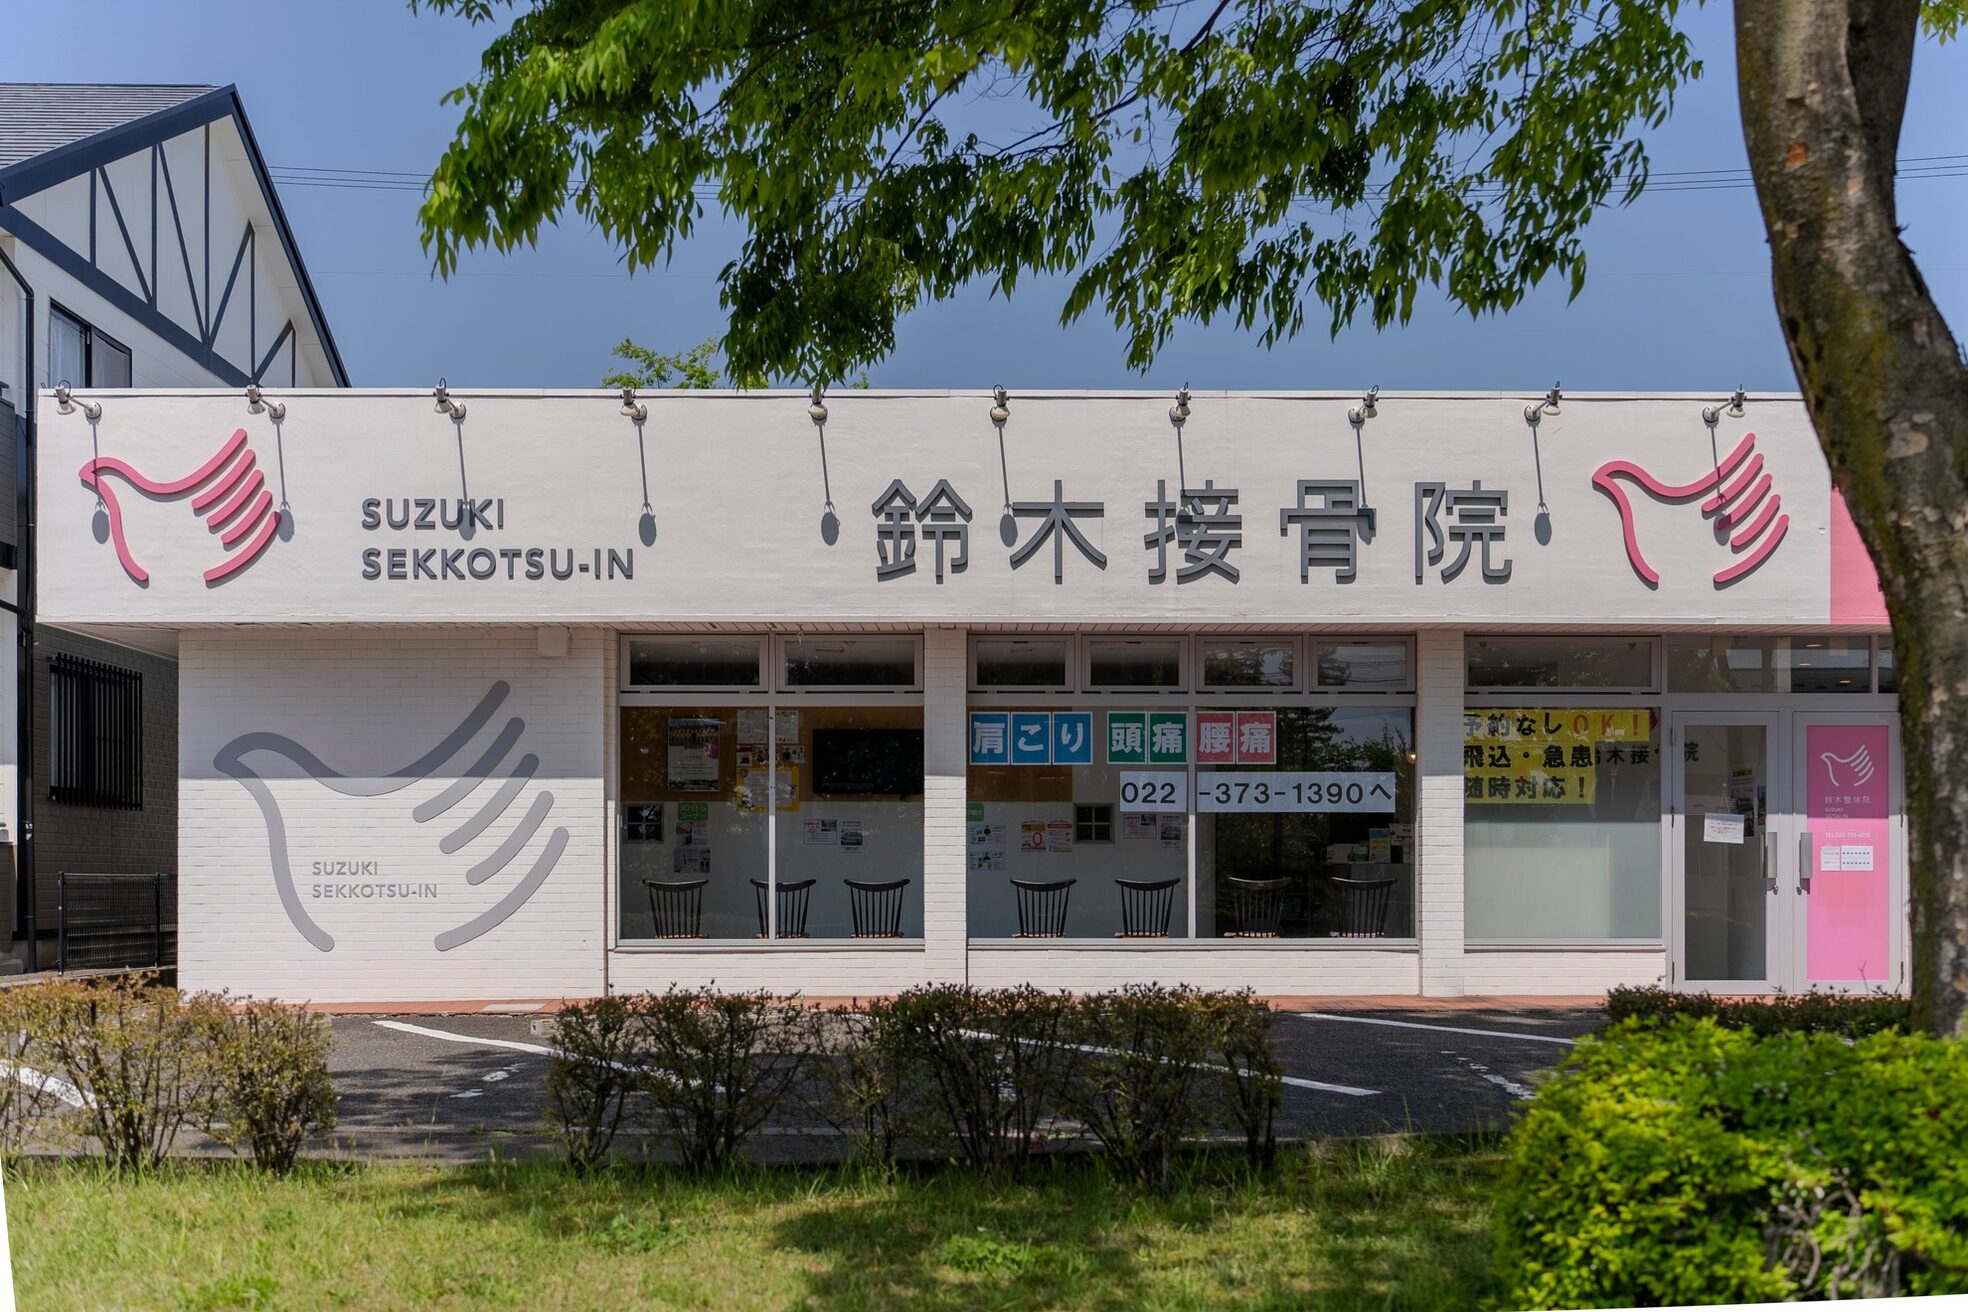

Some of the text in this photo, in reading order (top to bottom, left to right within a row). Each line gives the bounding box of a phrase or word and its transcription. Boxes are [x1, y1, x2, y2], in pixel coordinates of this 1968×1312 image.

[361, 498, 504, 530] SUZUKI
[872, 479, 1513, 585] 鈴木接骨院
[361, 547, 634, 580] SEKKOTSU-IN
[973, 721, 1272, 754] 肩こり 頭痛 腰痛
[312, 861, 378, 876] SUZUKI
[312, 883, 438, 899] SEKKOTSU-IN
